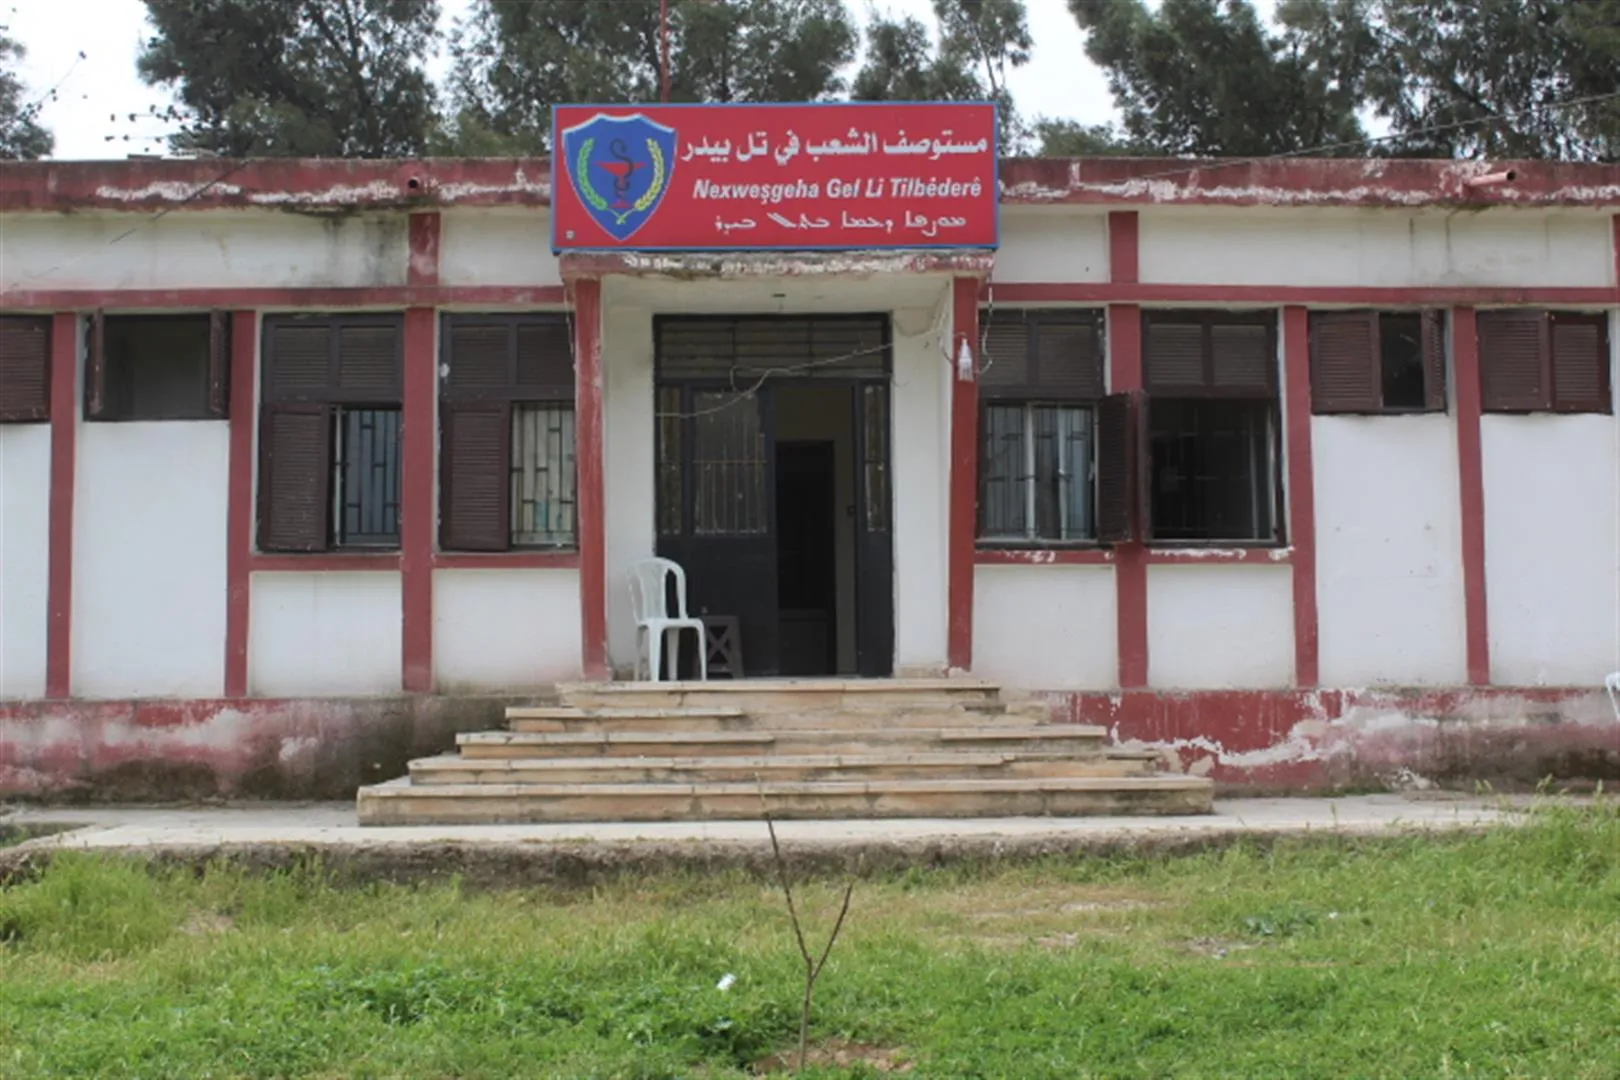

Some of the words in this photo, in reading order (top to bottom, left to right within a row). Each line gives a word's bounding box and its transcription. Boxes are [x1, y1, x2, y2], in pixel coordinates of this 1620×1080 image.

[680, 135, 731, 162] بيدر
[736, 131, 768, 162] تل
[774, 129, 800, 166] في
[805, 127, 878, 163] الشعب
[883, 129, 989, 161] مستوصف
[692, 178, 820, 205] Nexweşgeha
[826, 177, 861, 199] Gel
[865, 177, 885, 198] Li
